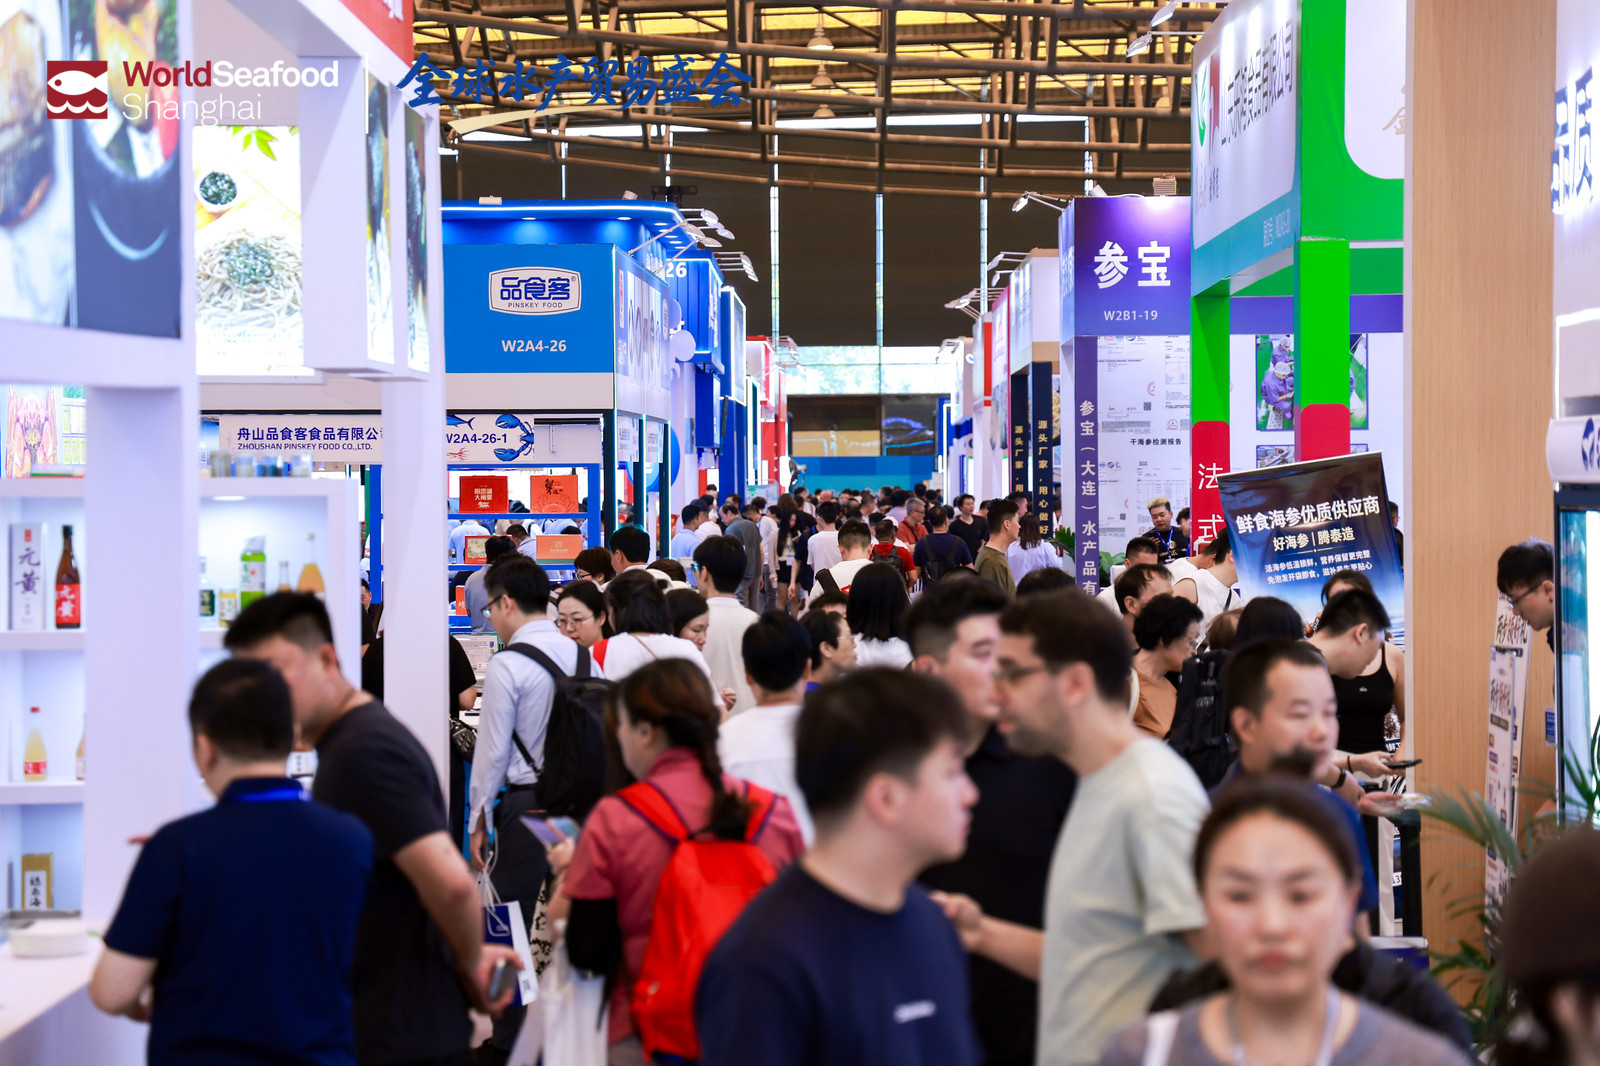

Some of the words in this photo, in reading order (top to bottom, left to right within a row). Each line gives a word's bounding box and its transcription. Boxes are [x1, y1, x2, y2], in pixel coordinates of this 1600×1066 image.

[1093, 240, 1172, 289] 参宝
[500, 277, 571, 300] 品食客
[1103, 310, 1159, 321] W2B1-19
[501, 340, 567, 352] W2A4-26
[237, 427, 382, 440] 舟山品食客食品有限公
[1235, 495, 1380, 534] 鲜食海参优质供应商
[1272, 533, 1309, 552] 好海参
[1317, 527, 1355, 545] 腾泰造
